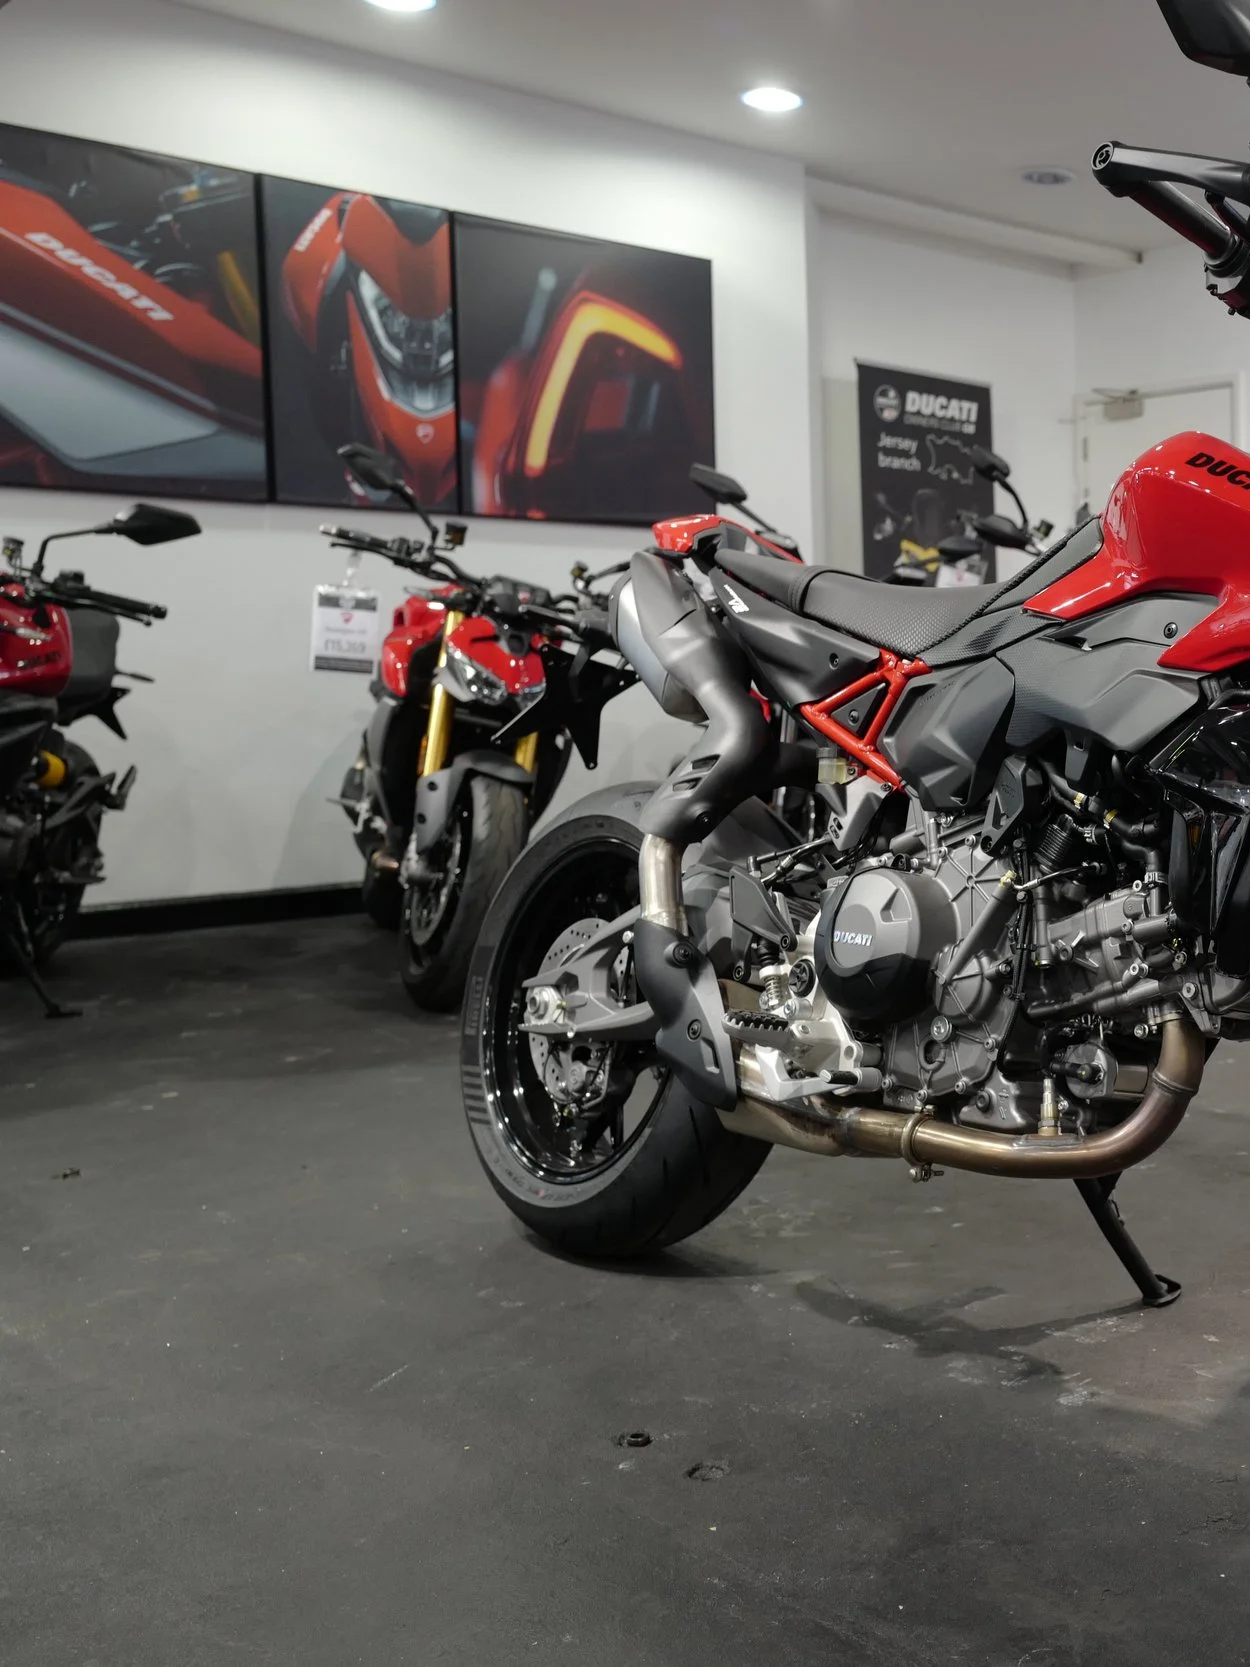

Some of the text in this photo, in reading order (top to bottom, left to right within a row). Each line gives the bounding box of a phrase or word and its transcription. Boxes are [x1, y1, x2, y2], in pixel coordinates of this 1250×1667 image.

[24, 232, 175, 321] DUCATI
[905, 390, 979, 423] DUCATI
[877, 432, 919, 454] Jersey
[877, 452, 922, 472] branch
[833, 930, 873, 947] DUCATI
